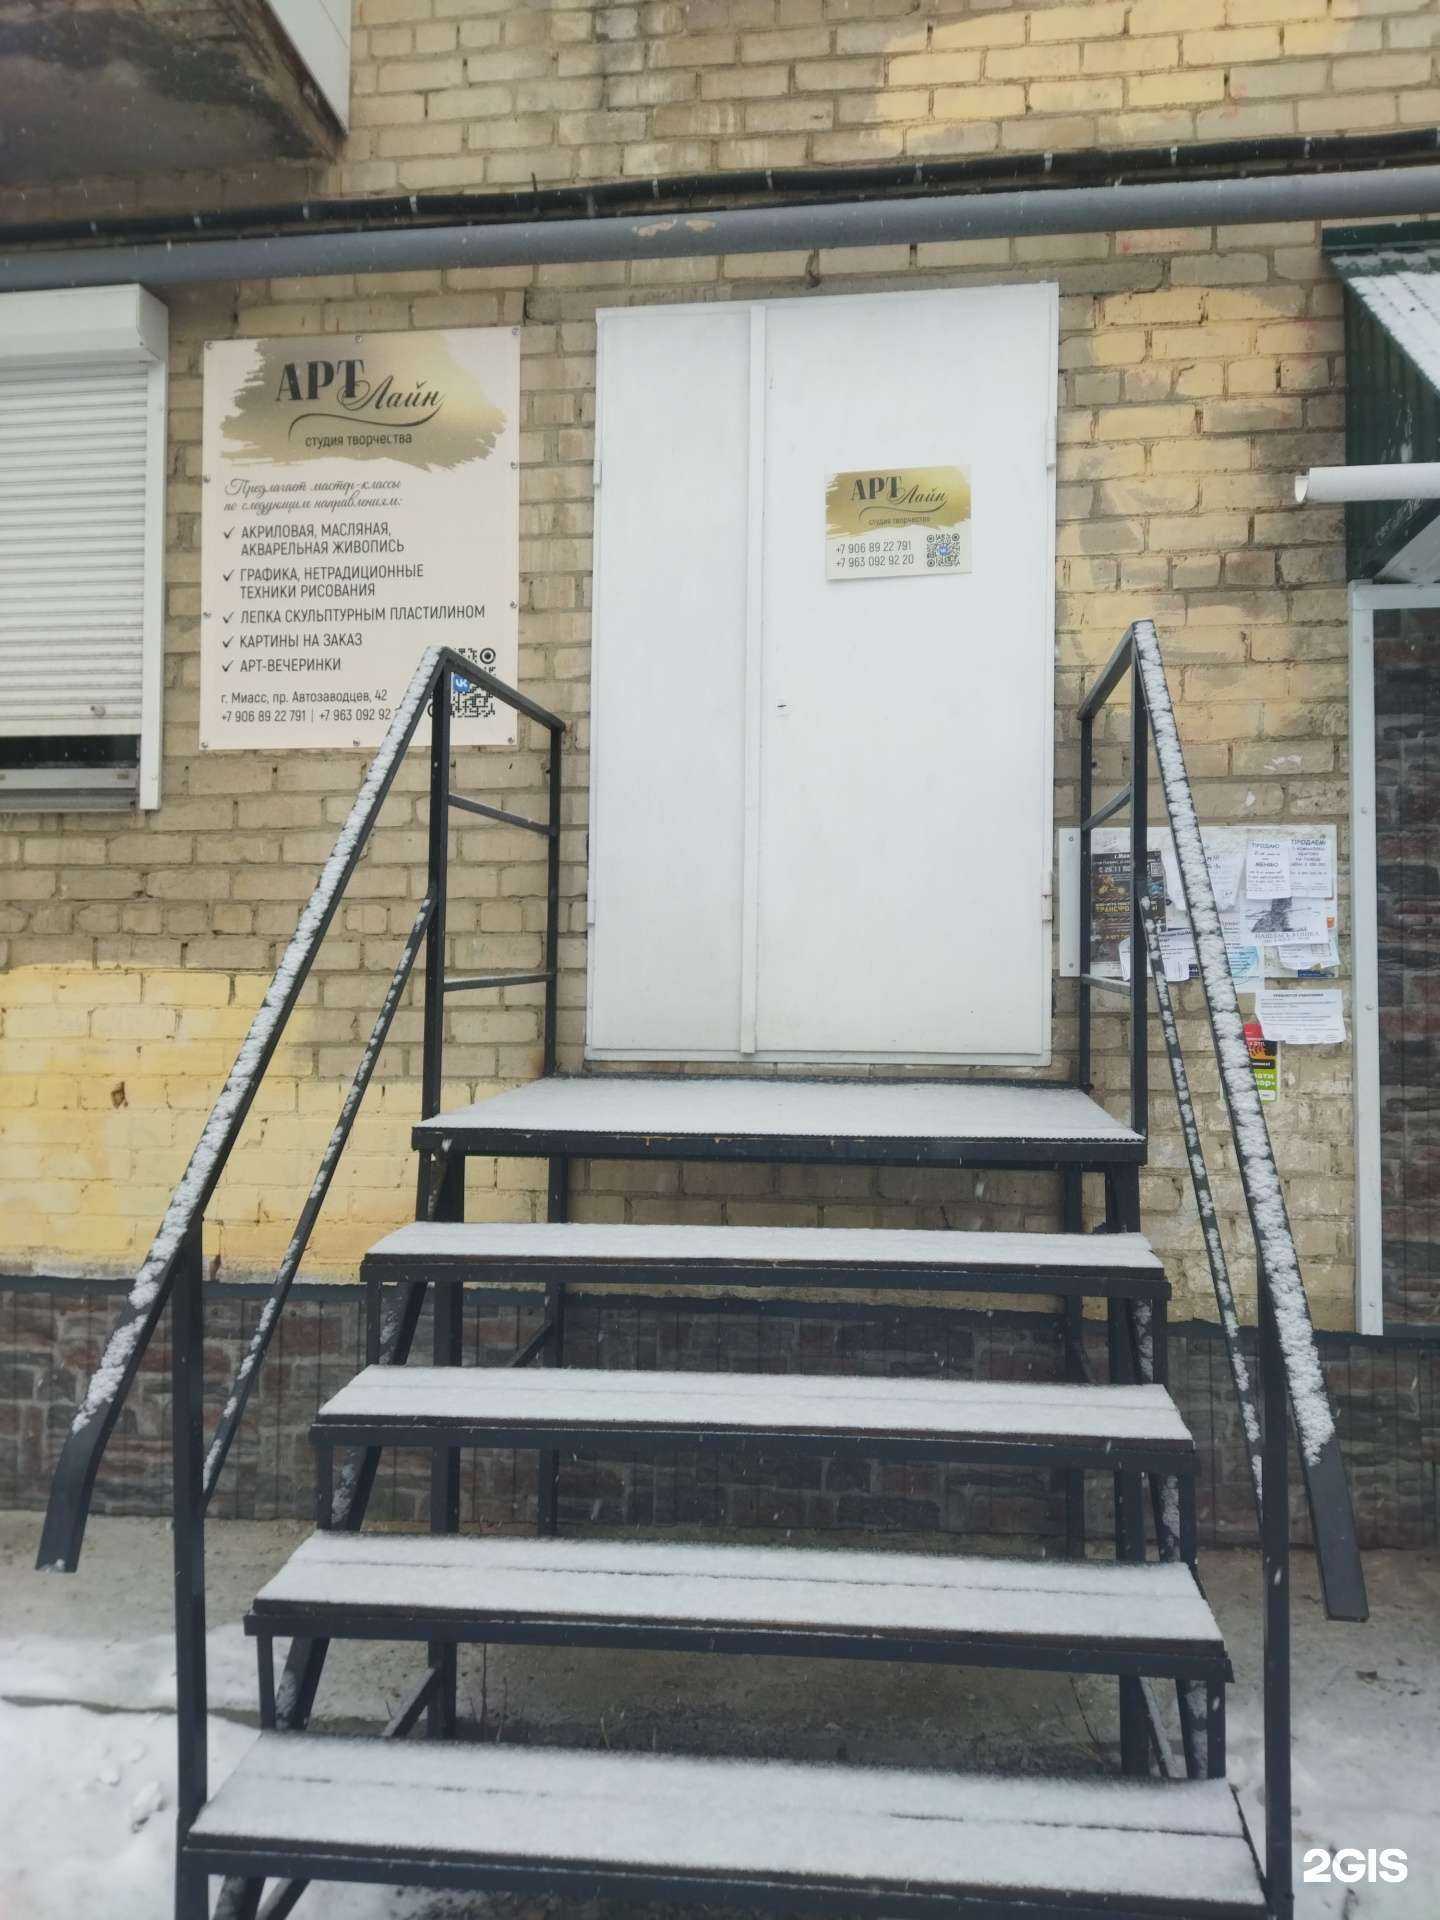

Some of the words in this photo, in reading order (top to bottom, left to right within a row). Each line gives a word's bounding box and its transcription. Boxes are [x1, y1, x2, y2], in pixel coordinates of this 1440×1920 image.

[276, 359, 365, 402] АРТ
[337, 375, 447, 411] Лайн
[305, 433, 344, 450] студия
[346, 432, 413, 447] творчества
[851, 475, 902, 501] АРТ
[888, 484, 947, 504] Лайн
[241, 524, 318, 540] АКРИЛОВАЯ,
[321, 522, 391, 539] МАСЛЯНАЯ,
[241, 540, 329, 556] АКВАРЕЛЬНАЯ
[332, 538, 404, 554] ЖИВОПИСЬ
[835, 543, 845, 554] +7
[848, 542, 866, 554] 906
[869, 542, 881, 553] 89
[883, 541, 895, 552] 22
[897, 540, 912, 552] 791
[835, 557, 846, 568] +7
[849, 557, 866, 568] 963
[868, 556, 886, 567] 092
[888, 555, 900, 567] 92
[902, 554, 914, 565] 20
[240, 567, 300, 582] ГРАФИКА,
[304, 564, 424, 581] НЕТРАДИЦИОННЫЕ
[240, 585, 297, 599] ТЕХНИКИ
[300, 583, 375, 598] РИСОВАНИЯ
[240, 609, 281, 624] ЛЕПКА
[285, 606, 386, 623] СКУЛЬПТУРНЫМ
[390, 604, 486, 621] ПЛАСТИЛИНОМ
[240, 634, 299, 648] КАРТИНЫ
[303, 634, 320, 647] НА
[323, 632, 363, 647] ЗАКАЗ
[240, 658, 341, 672] АРТ-ВЕЧЕРИНКИ
[220, 693, 228, 704] г.
[231, 691, 270, 704] Миасс,
[272, 692, 289, 705] пр.
[292, 690, 372, 704] Автозаводцев,
[375, 689, 388, 701] 42
[222, 711, 231, 722] +7
[235, 711, 255, 722] 906
[258, 710, 271, 722] 89
[274, 710, 287, 722] 22
[290, 710, 306, 722] 791
[319, 709, 331, 720] +7
[333, 709, 352, 721] 963
[355, 708, 375, 720] 092
[378, 708, 392, 720] 92
